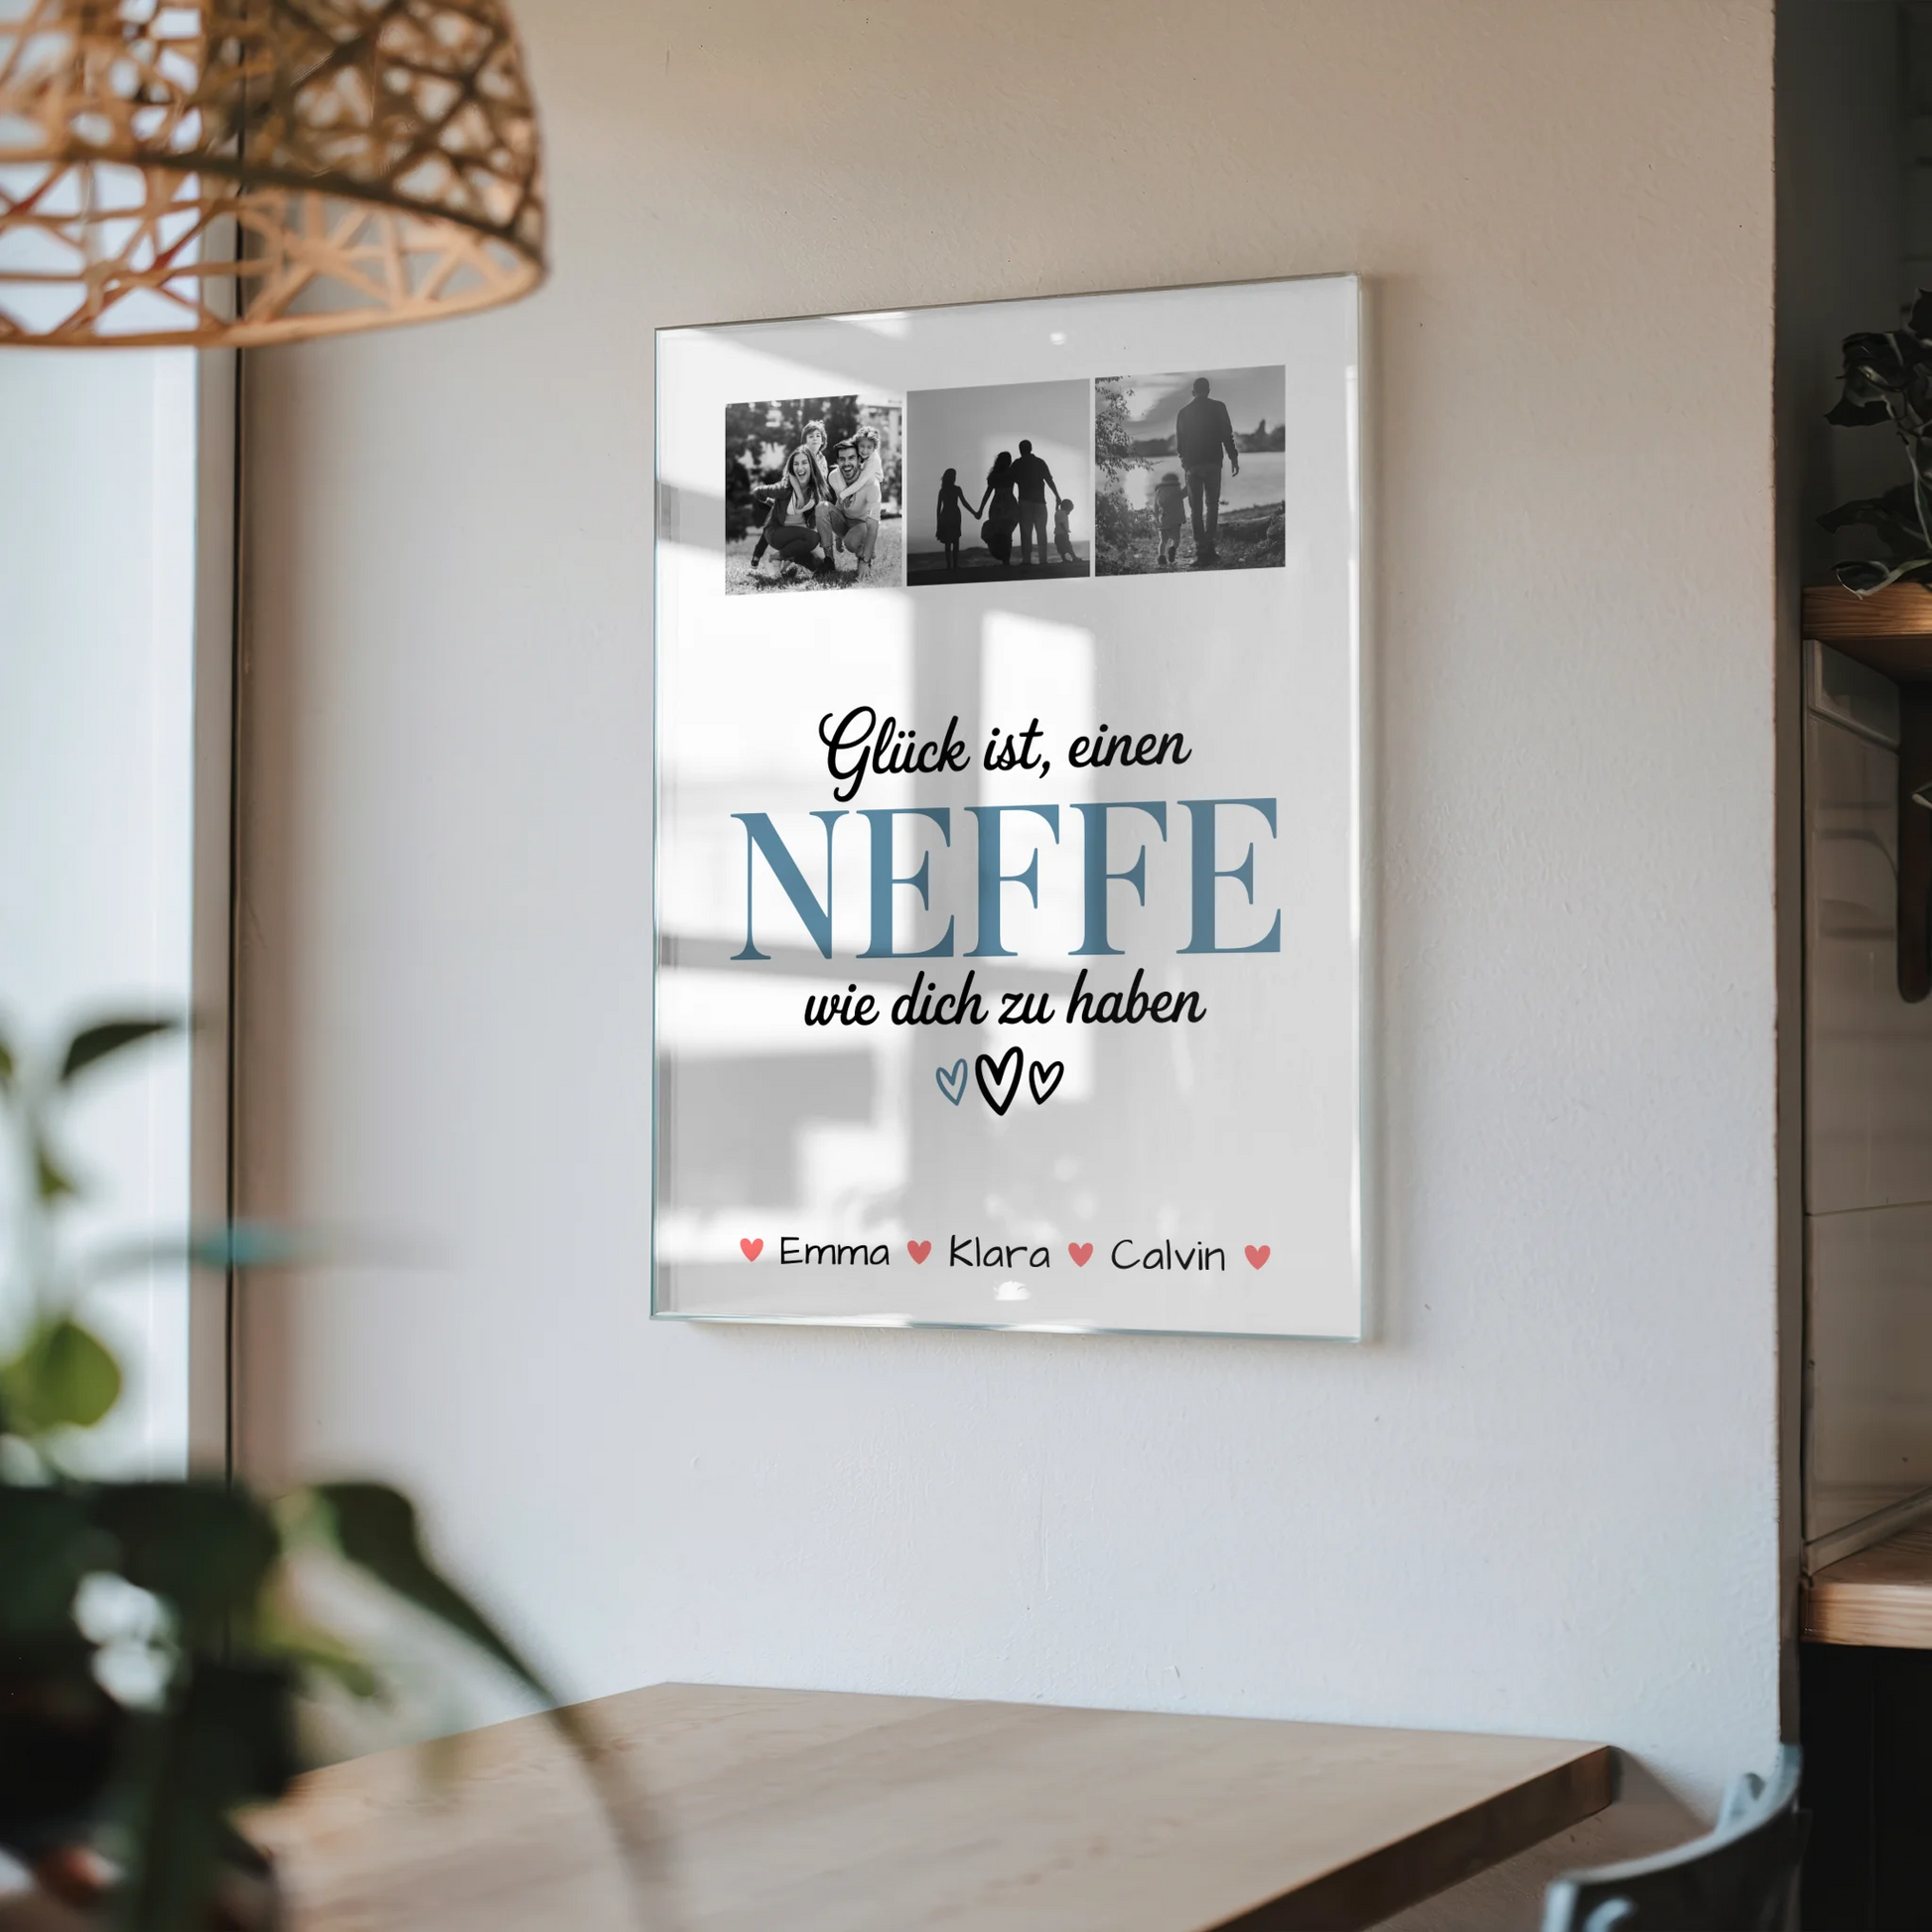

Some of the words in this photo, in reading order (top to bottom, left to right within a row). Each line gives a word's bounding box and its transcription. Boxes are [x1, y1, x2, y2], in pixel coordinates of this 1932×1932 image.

[819, 706, 971, 803] Glück
[983, 718, 1050, 779] ist,
[1068, 724, 1192, 768] einen
[729, 797, 1282, 962] NEFFE
[804, 983, 880, 1027] wie
[891, 969, 989, 1026] dich
[998, 992, 1055, 1025] zu
[1065, 967, 1207, 1025] haben
[780, 1236, 890, 1266] Emma
[949, 1234, 1050, 1269] Klara
[1111, 1239, 1225, 1272] Calvin
